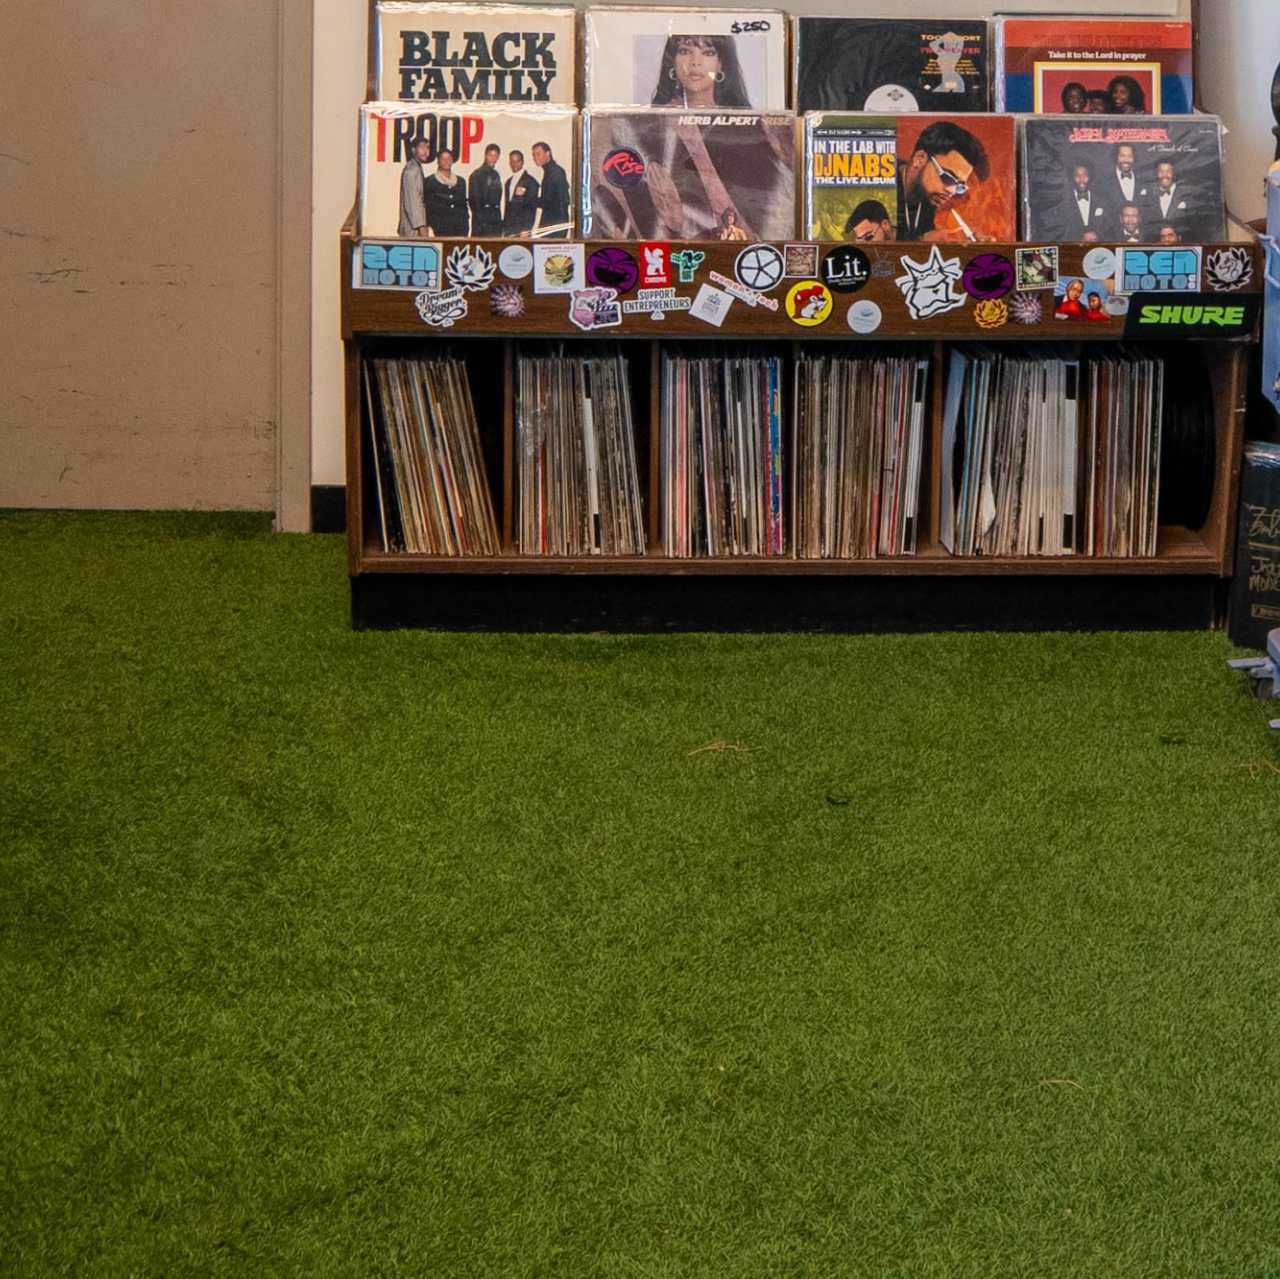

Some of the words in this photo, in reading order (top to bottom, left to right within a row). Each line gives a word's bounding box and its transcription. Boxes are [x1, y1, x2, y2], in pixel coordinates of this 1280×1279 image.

[731, 20, 771, 34] $250
[399, 30, 557, 69] BLACK
[1048, 51, 1065, 59] Take
[1073, 51, 1082, 59] to
[1082, 51, 1095, 59] the
[1095, 51, 1113, 60] Lord
[1122, 52, 1147, 61] prayer
[398, 68, 557, 101] FAMILY
[678, 116, 712, 126] HERB
[712, 116, 760, 126] ALPERT
[369, 112, 485, 164] TROOP
[814, 140, 826, 153] IN
[828, 140, 851, 153] THE
[852, 140, 874, 153] LAB
[875, 140, 896, 153] WITH
[602, 151, 645, 177] Rise
[826, 255, 868, 278] Lit.
[420, 289, 458, 307] Dream
[639, 290, 674, 300] SUPPORT
[624, 299, 691, 312] ENTREPRENEURS
[1139, 305, 1245, 326] SHURE
